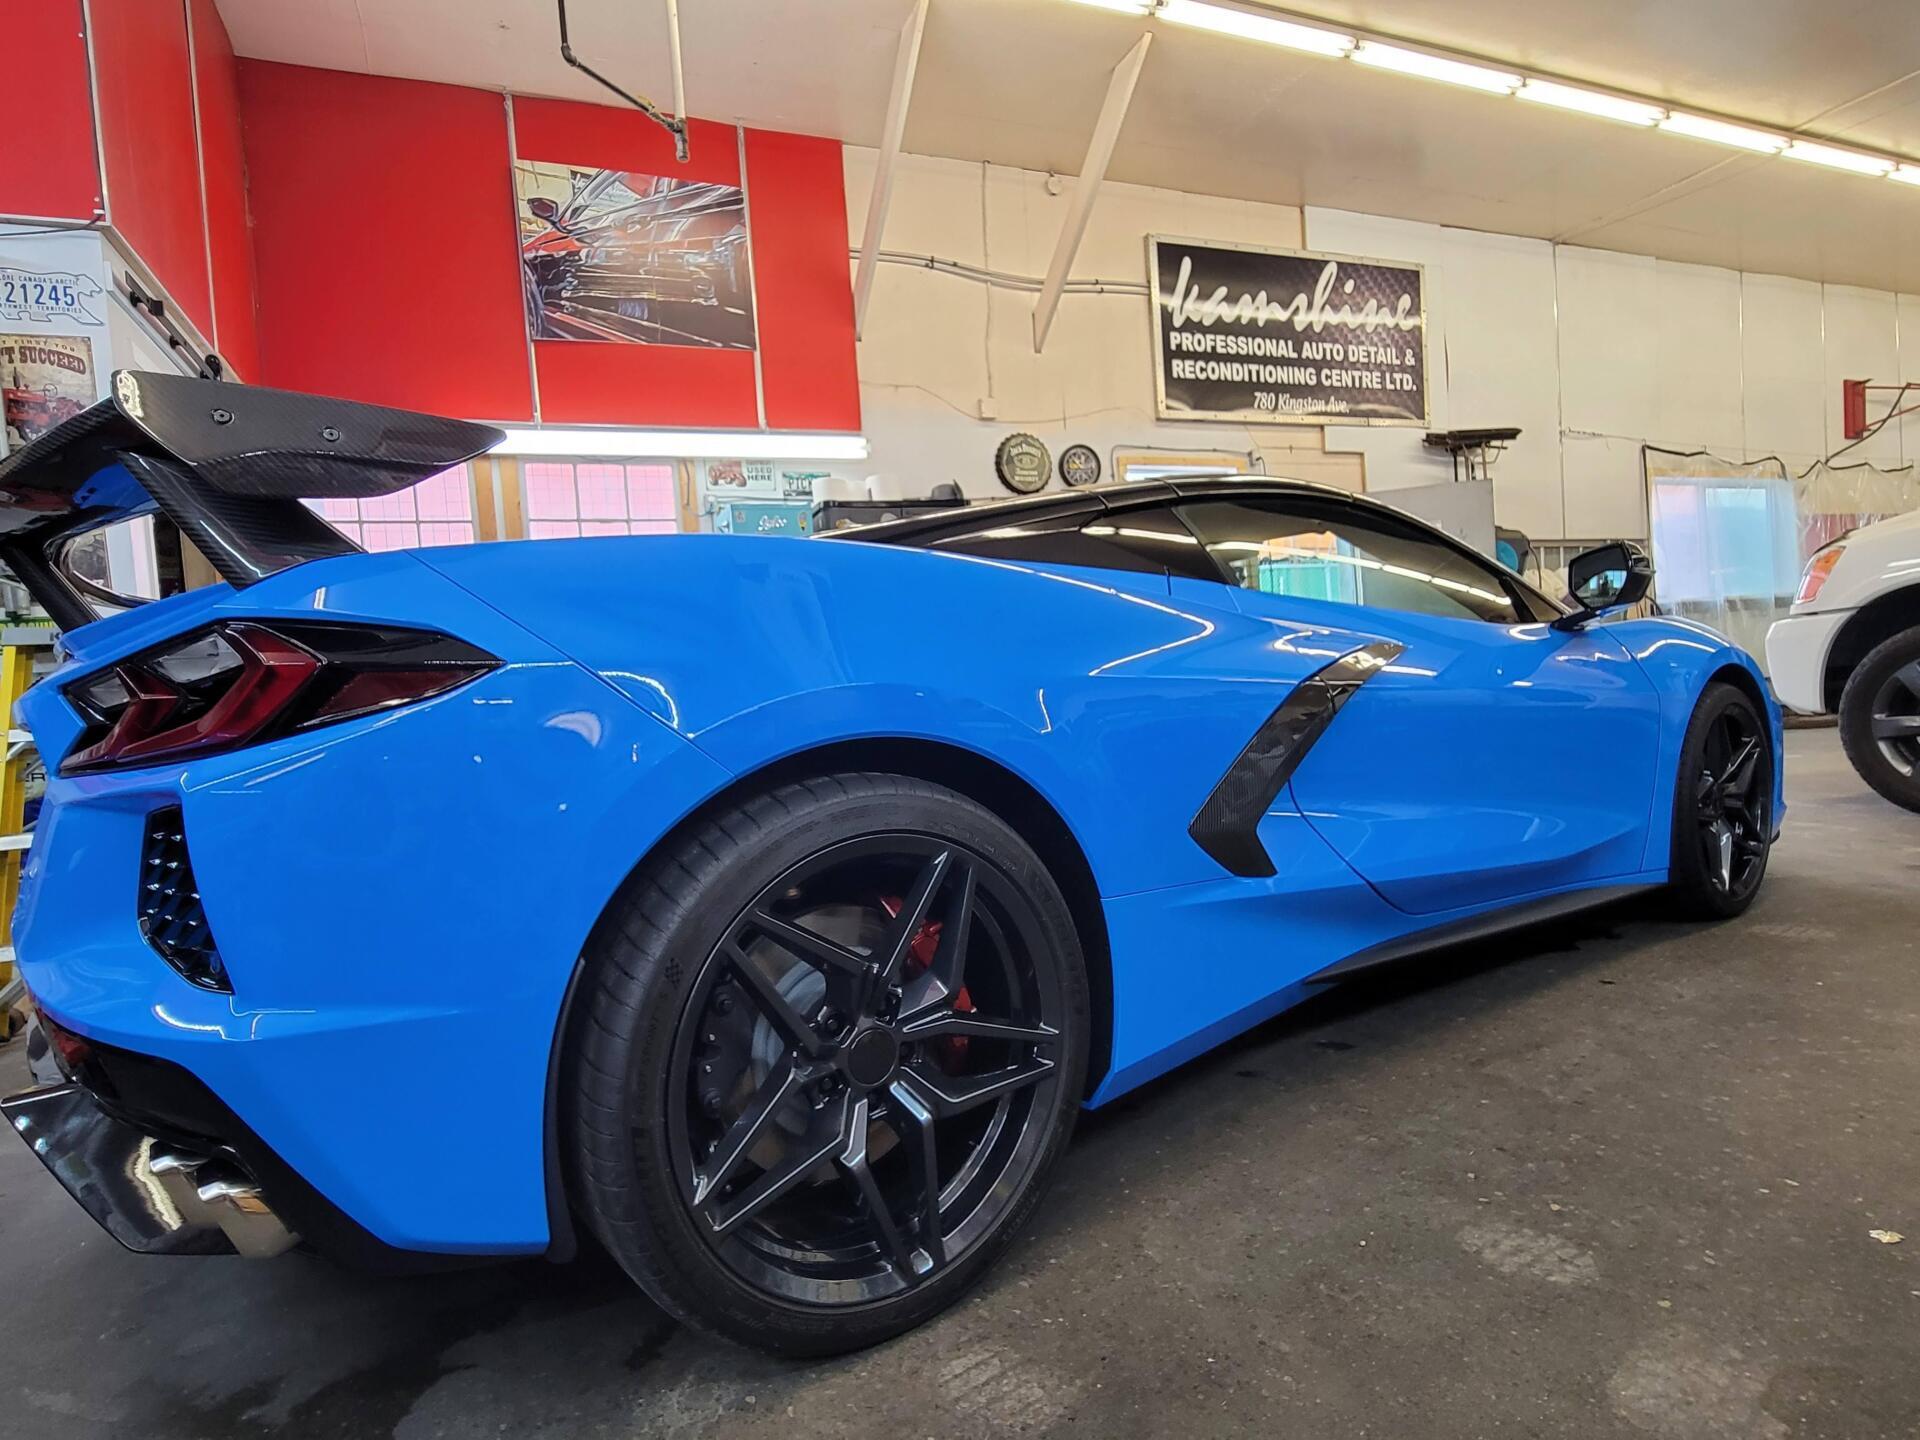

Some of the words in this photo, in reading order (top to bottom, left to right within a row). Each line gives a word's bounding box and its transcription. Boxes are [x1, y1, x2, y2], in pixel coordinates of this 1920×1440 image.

[19, 345, 86, 375] SUCCEED
[1169, 331, 1298, 359] PROFESSIONAL
[1301, 341, 1344, 361] AUTO
[1348, 345, 1401, 365] DETAIL
[1405, 348, 1416, 366] &
[1171, 358, 1317, 386] RECONDITIONING
[1320, 368, 1382, 390] CENTRE
[1386, 372, 1417, 392] LTD.
[1253, 391, 1276, 410] 780
[1278, 393, 1325, 414] Kingston
